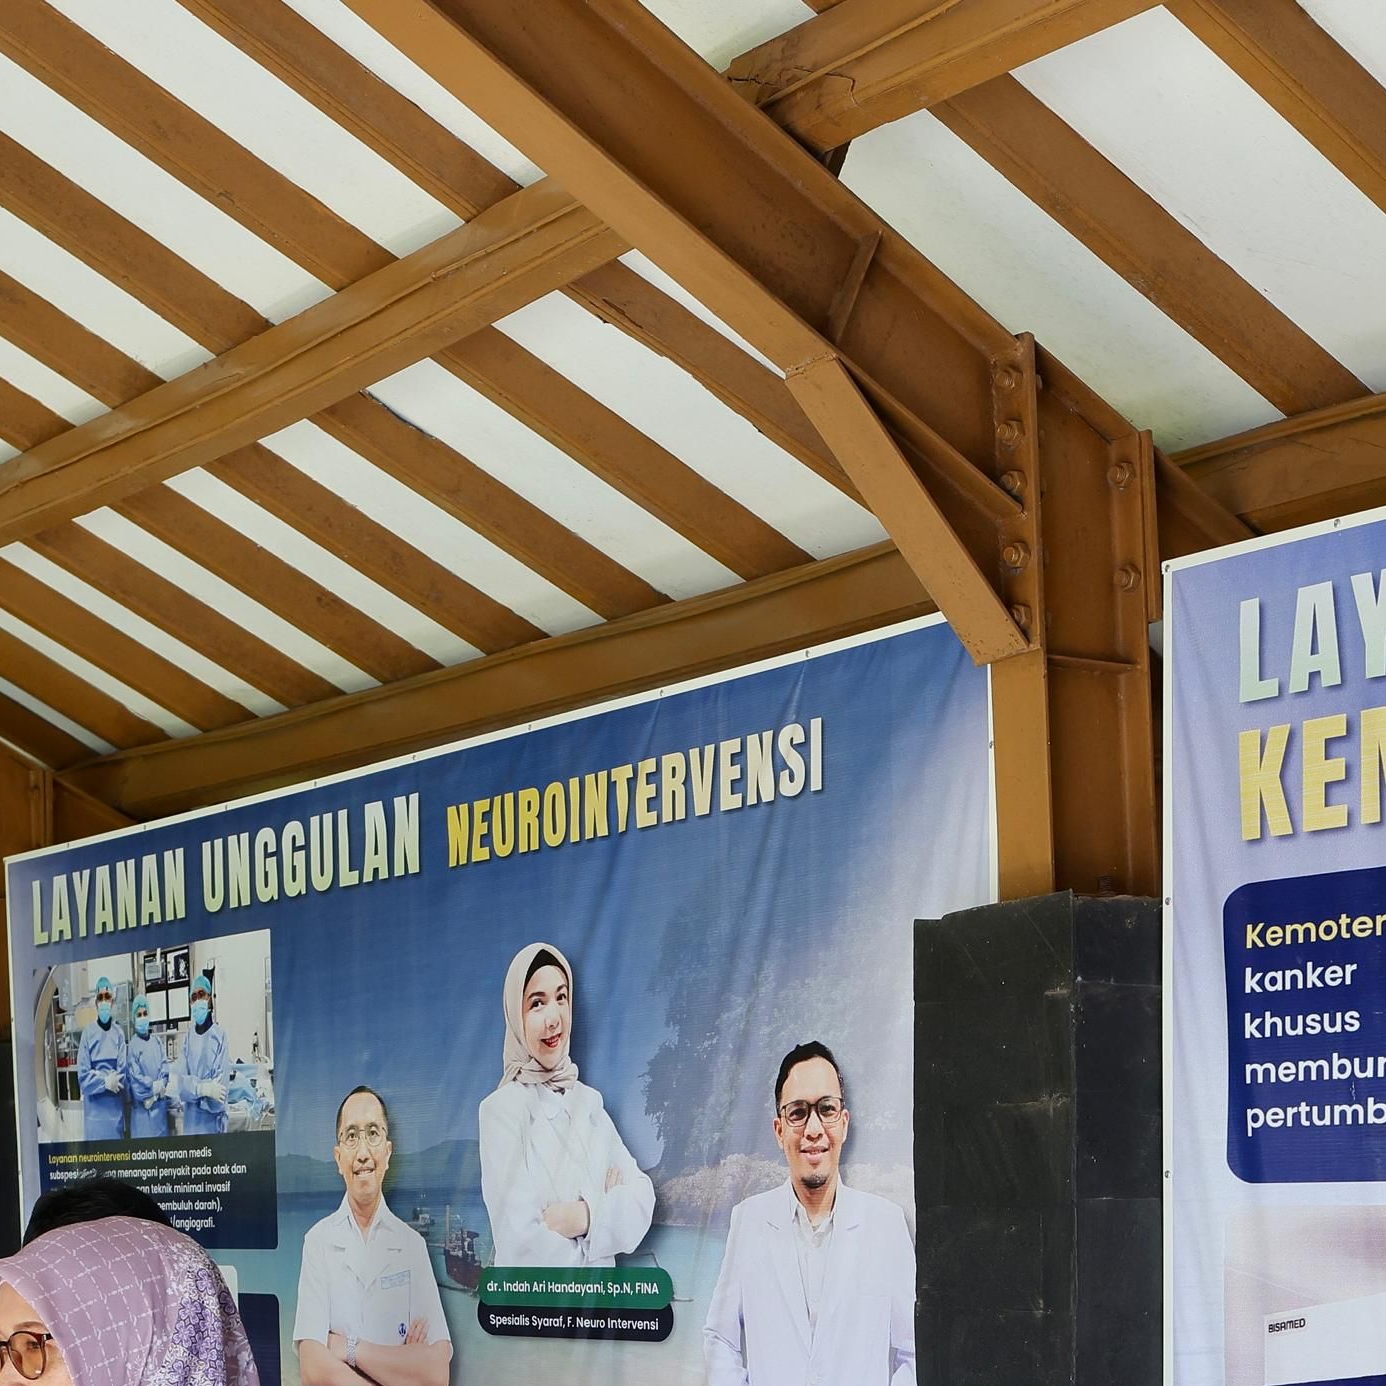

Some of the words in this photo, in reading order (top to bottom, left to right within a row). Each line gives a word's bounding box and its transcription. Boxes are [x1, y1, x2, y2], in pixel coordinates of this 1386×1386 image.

[31, 849, 186, 945] LAYANAN
[203, 792, 419, 912] UNGGULAN
[448, 717, 822, 867] NEUROINTERVENSI
[1245, 962, 1357, 993] kanker
[1245, 1011, 1360, 1038] khusus
[49, 1155, 77, 1166] Layanan
[79, 1153, 130, 1162] neurointervensi
[132, 1150, 157, 1160] adalah
[158, 1150, 187, 1162] layanan
[189, 1147, 212, 1157] medis
[118, 1166, 158, 1180] menangani
[159, 1165, 190, 1179] penyakit
[192, 1165, 211, 1178] pada
[213, 1164, 230, 1174] otak
[231, 1163, 246, 1173] dan
[151, 1183, 172, 1193] teknik
[174, 1182, 204, 1192] minimal
[206, 1181, 230, 1192] invasif
[195, 1197, 222, 1212] darah),
[487, 1281, 501, 1291] dr.
[504, 1281, 530, 1292] Indah
[533, 1282, 545, 1292] Ari
[548, 1281, 605, 1296] Handayani,
[608, 1282, 633, 1297] Sp.N,
[636, 1283, 658, 1294] FINA
[490, 1314, 529, 1328] Spesialis
[532, 1316, 565, 1329] Syaraf,
[568, 1317, 574, 1327] F.
[577, 1317, 605, 1328] Neuro
[608, 1318, 658, 1330] Intervensi
